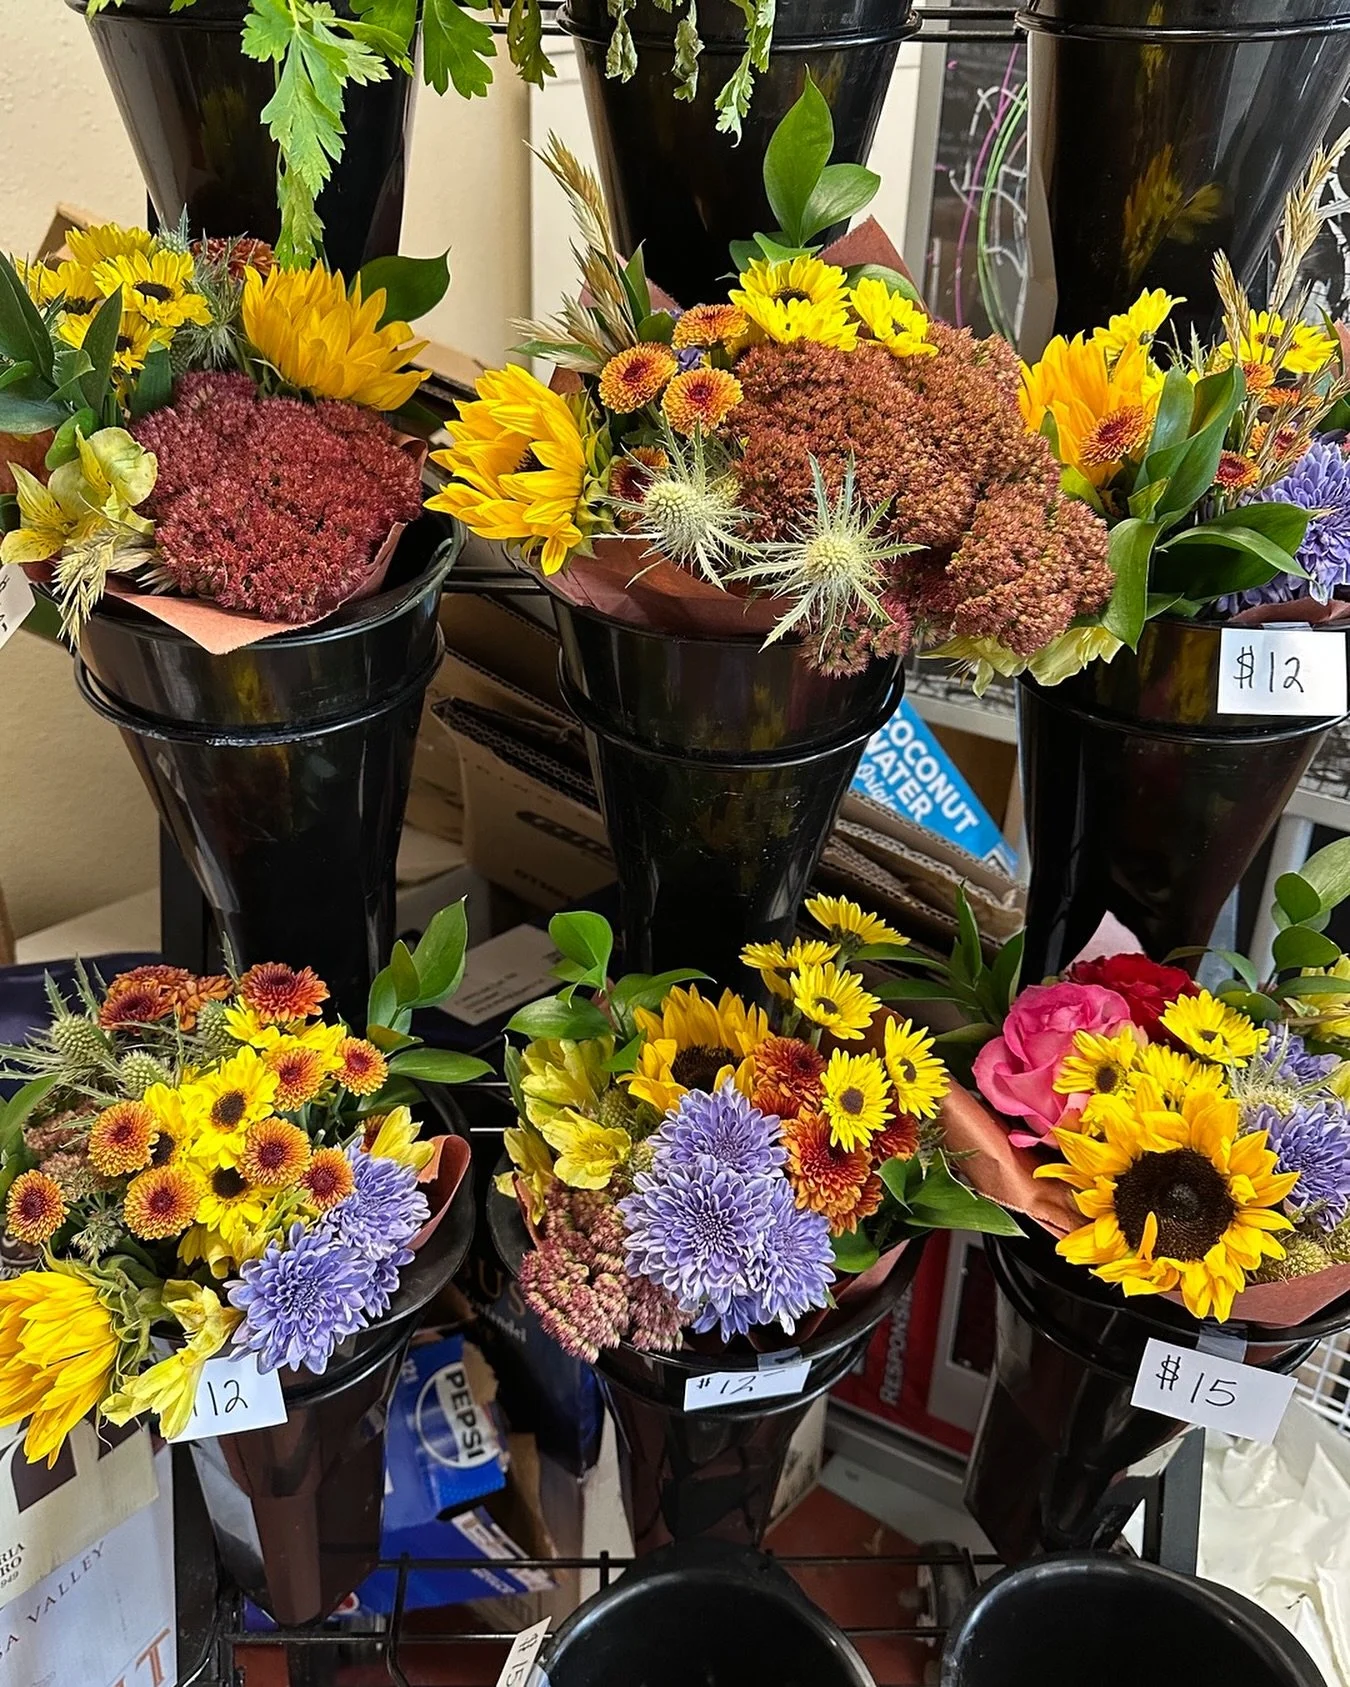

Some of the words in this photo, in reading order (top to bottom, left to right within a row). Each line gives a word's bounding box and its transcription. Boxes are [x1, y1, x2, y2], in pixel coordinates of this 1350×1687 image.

[1233, 645, 1304, 692] $12
[193, 1379, 249, 1417] 12
[1156, 1354, 1237, 1407] $15
[445, 1368, 486, 1460] PEPSI
[26, 1540, 105, 1625] VALLEY
